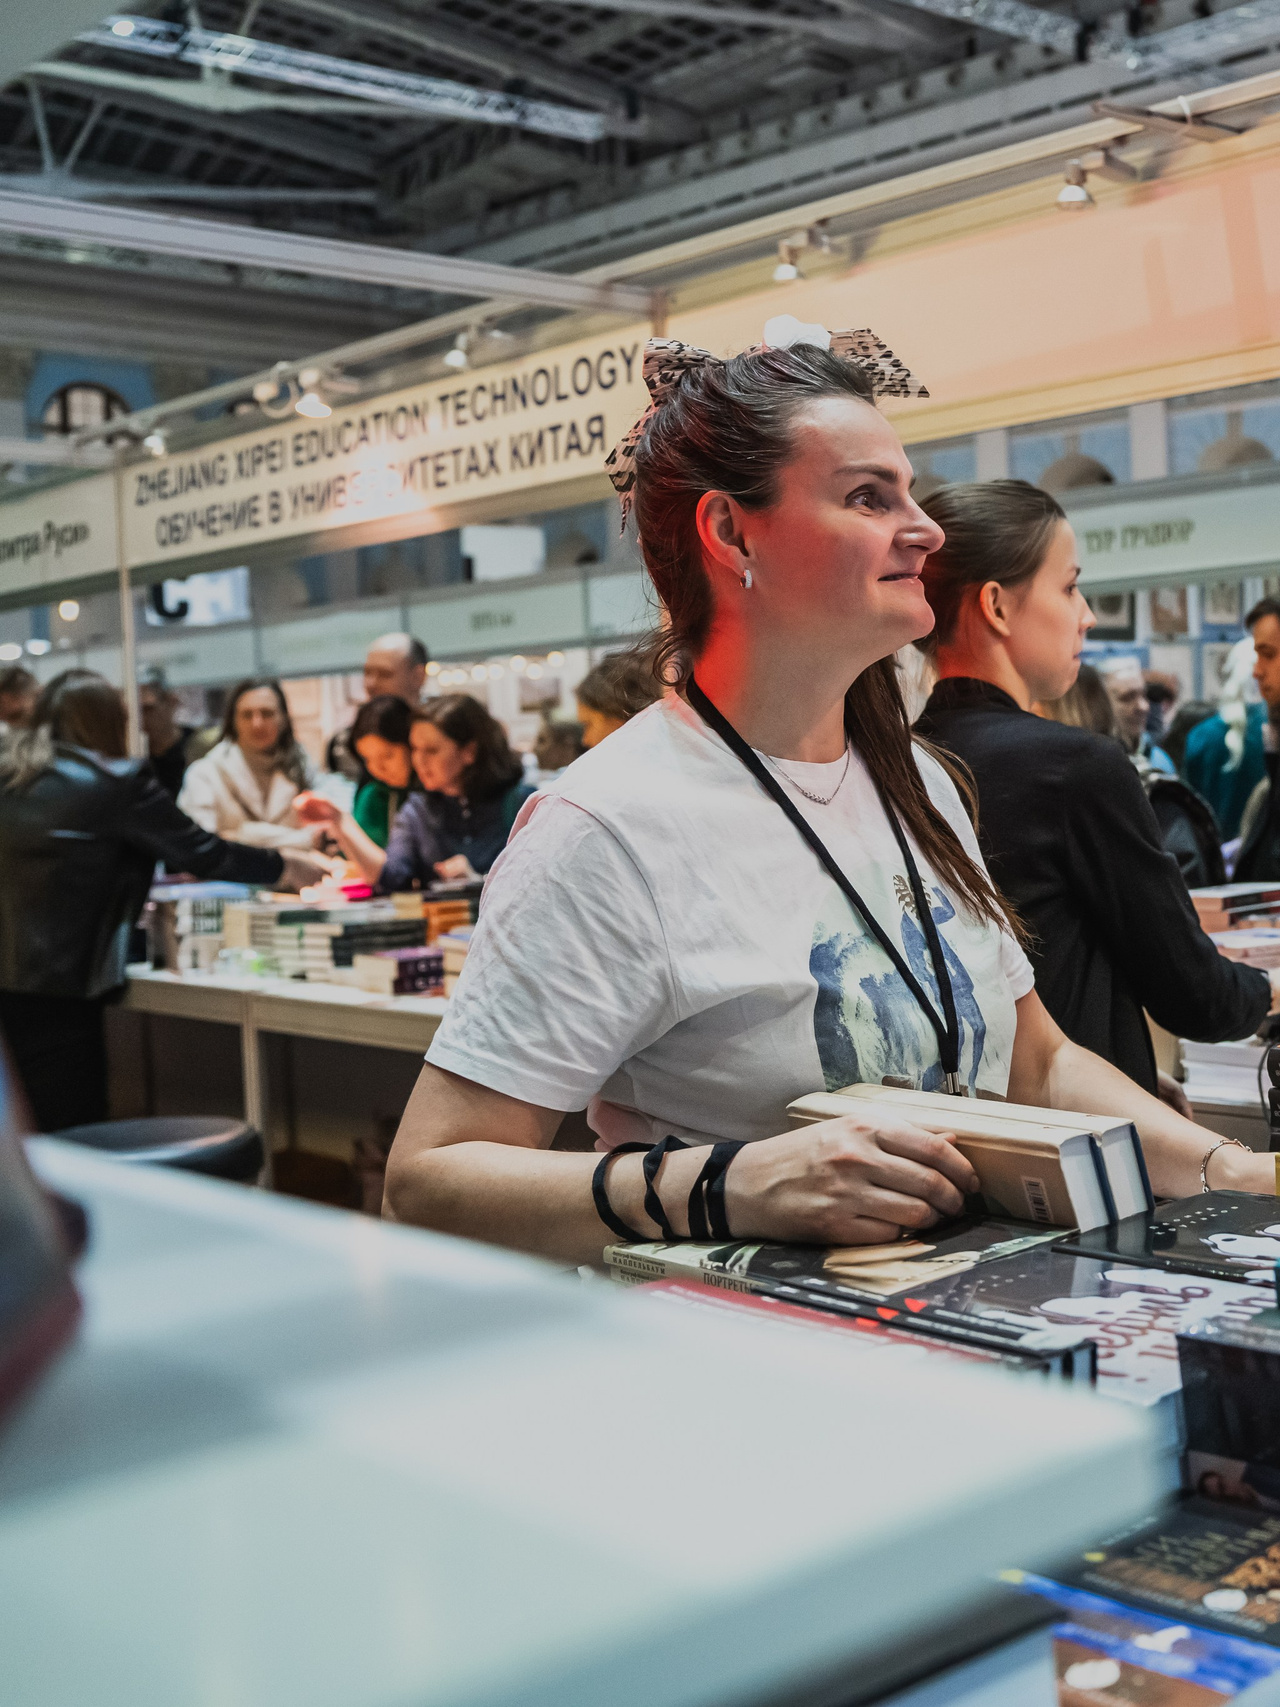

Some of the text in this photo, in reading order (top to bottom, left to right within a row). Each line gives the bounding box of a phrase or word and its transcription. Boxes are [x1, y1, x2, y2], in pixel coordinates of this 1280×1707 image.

[135, 343, 641, 507] ZHEJIANG XIPEI EDUCATION TECHNOLOGY
[155, 495, 262, 548] ОБУЧЕНИЕ
[267, 490, 283, 526] В
[508, 415, 606, 472] КИТАЯ
[703, 1272, 752, 1294] ПОРТРЕТЫ
